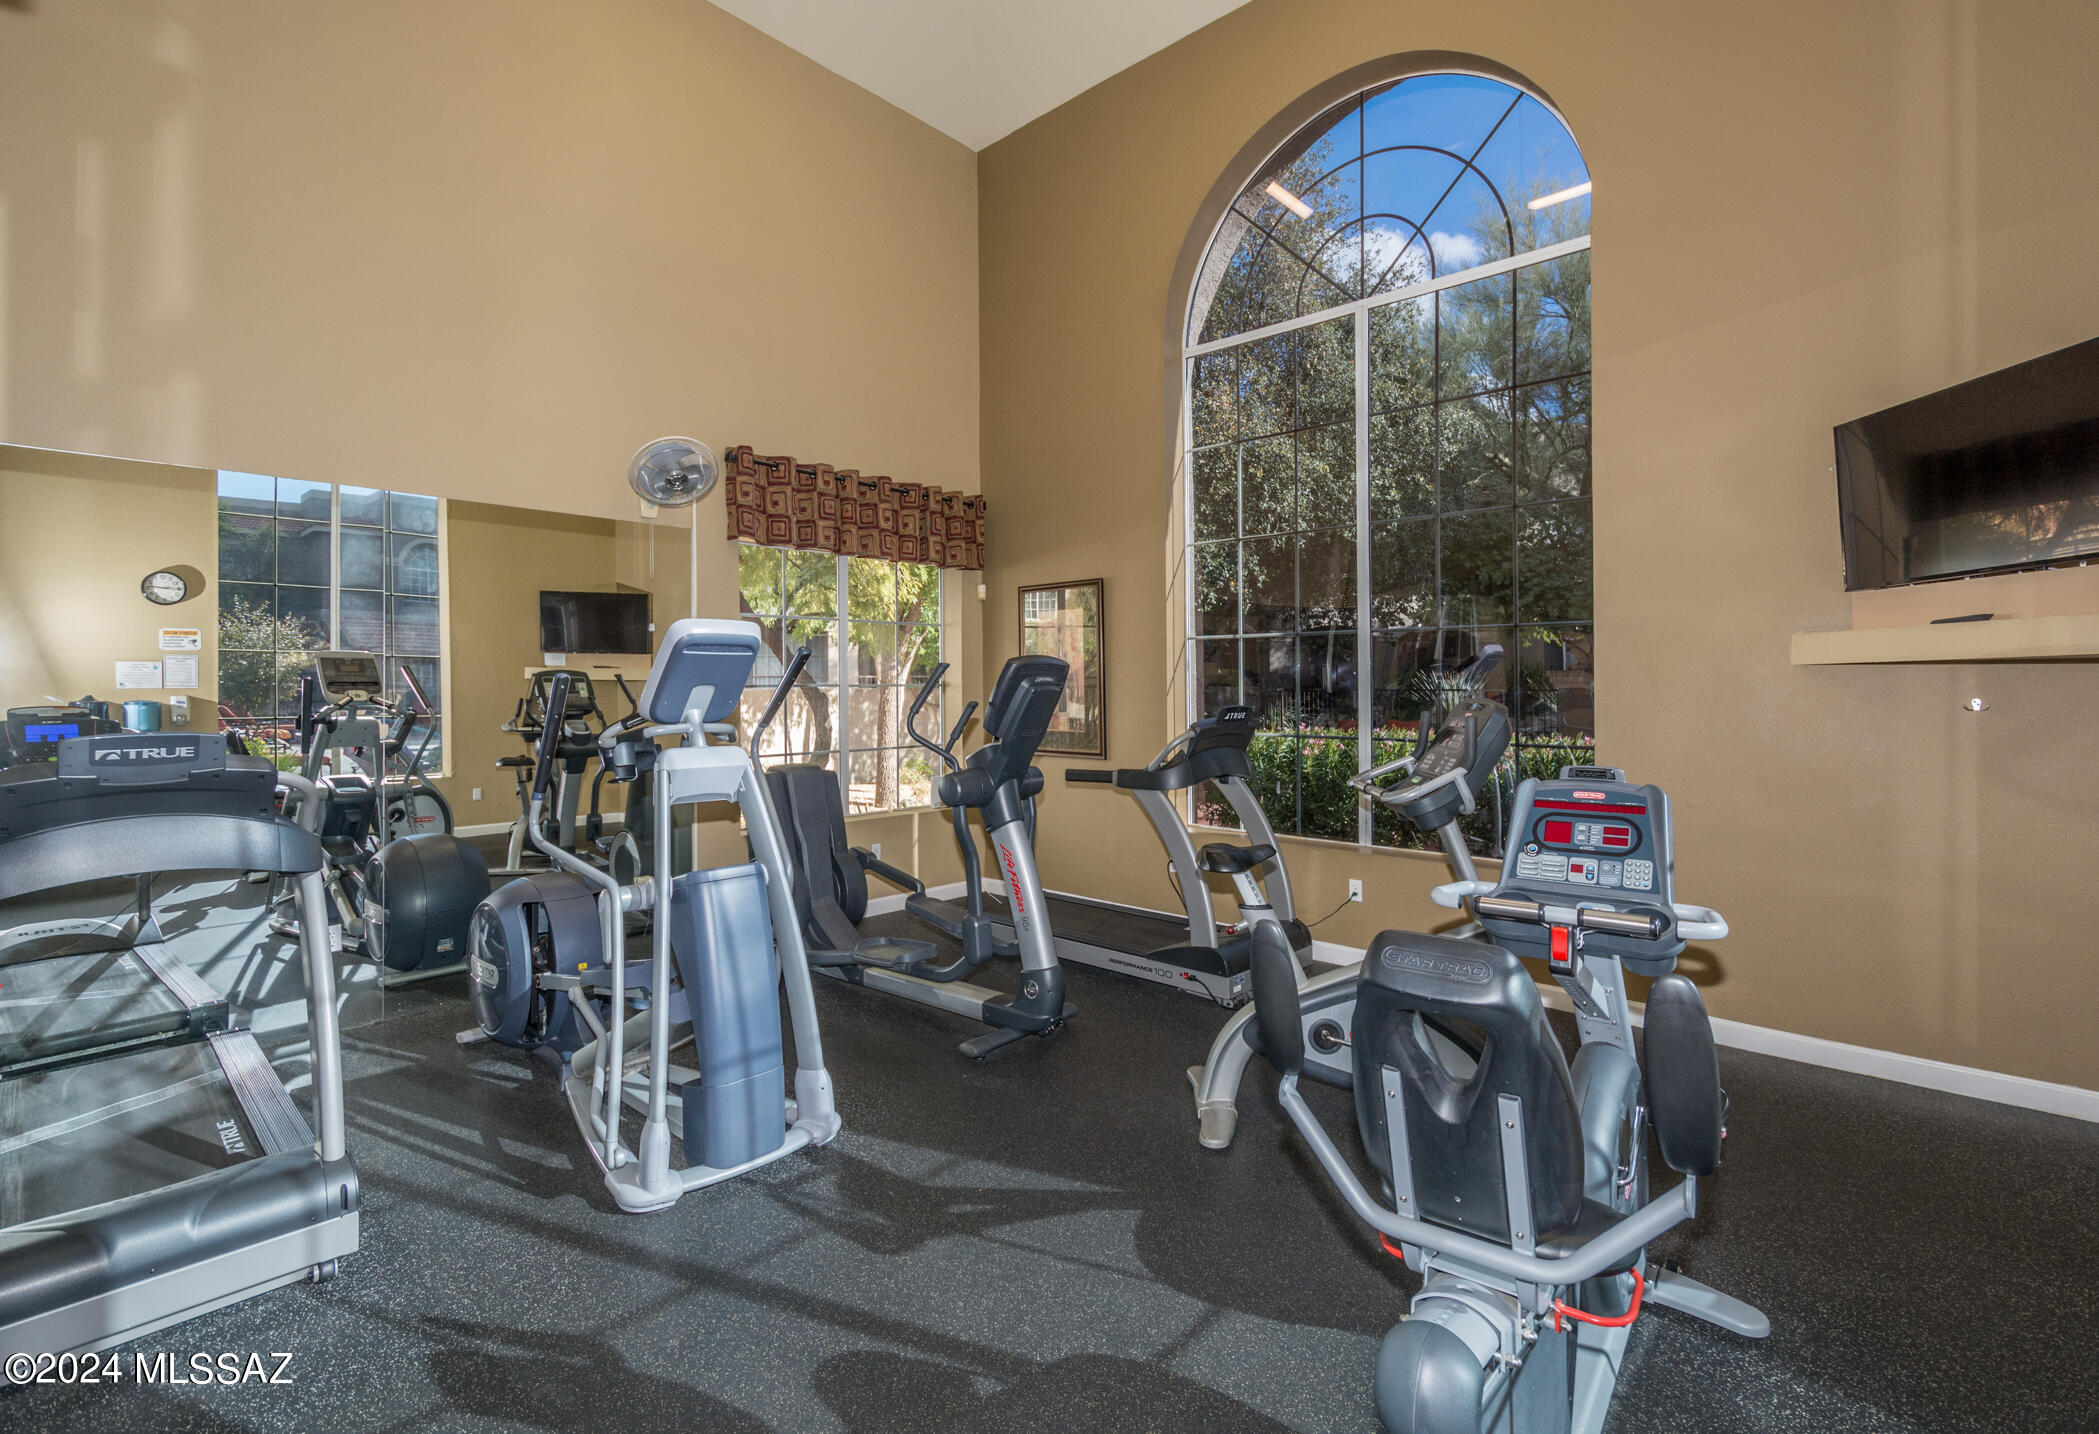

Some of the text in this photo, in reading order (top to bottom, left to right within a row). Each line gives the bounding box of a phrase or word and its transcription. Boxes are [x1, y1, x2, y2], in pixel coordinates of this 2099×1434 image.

[123, 747, 195, 759] TRUE
[1109, 958, 1172, 979] PERFORMANCE 100
[216, 1119, 241, 1147] TRUE
